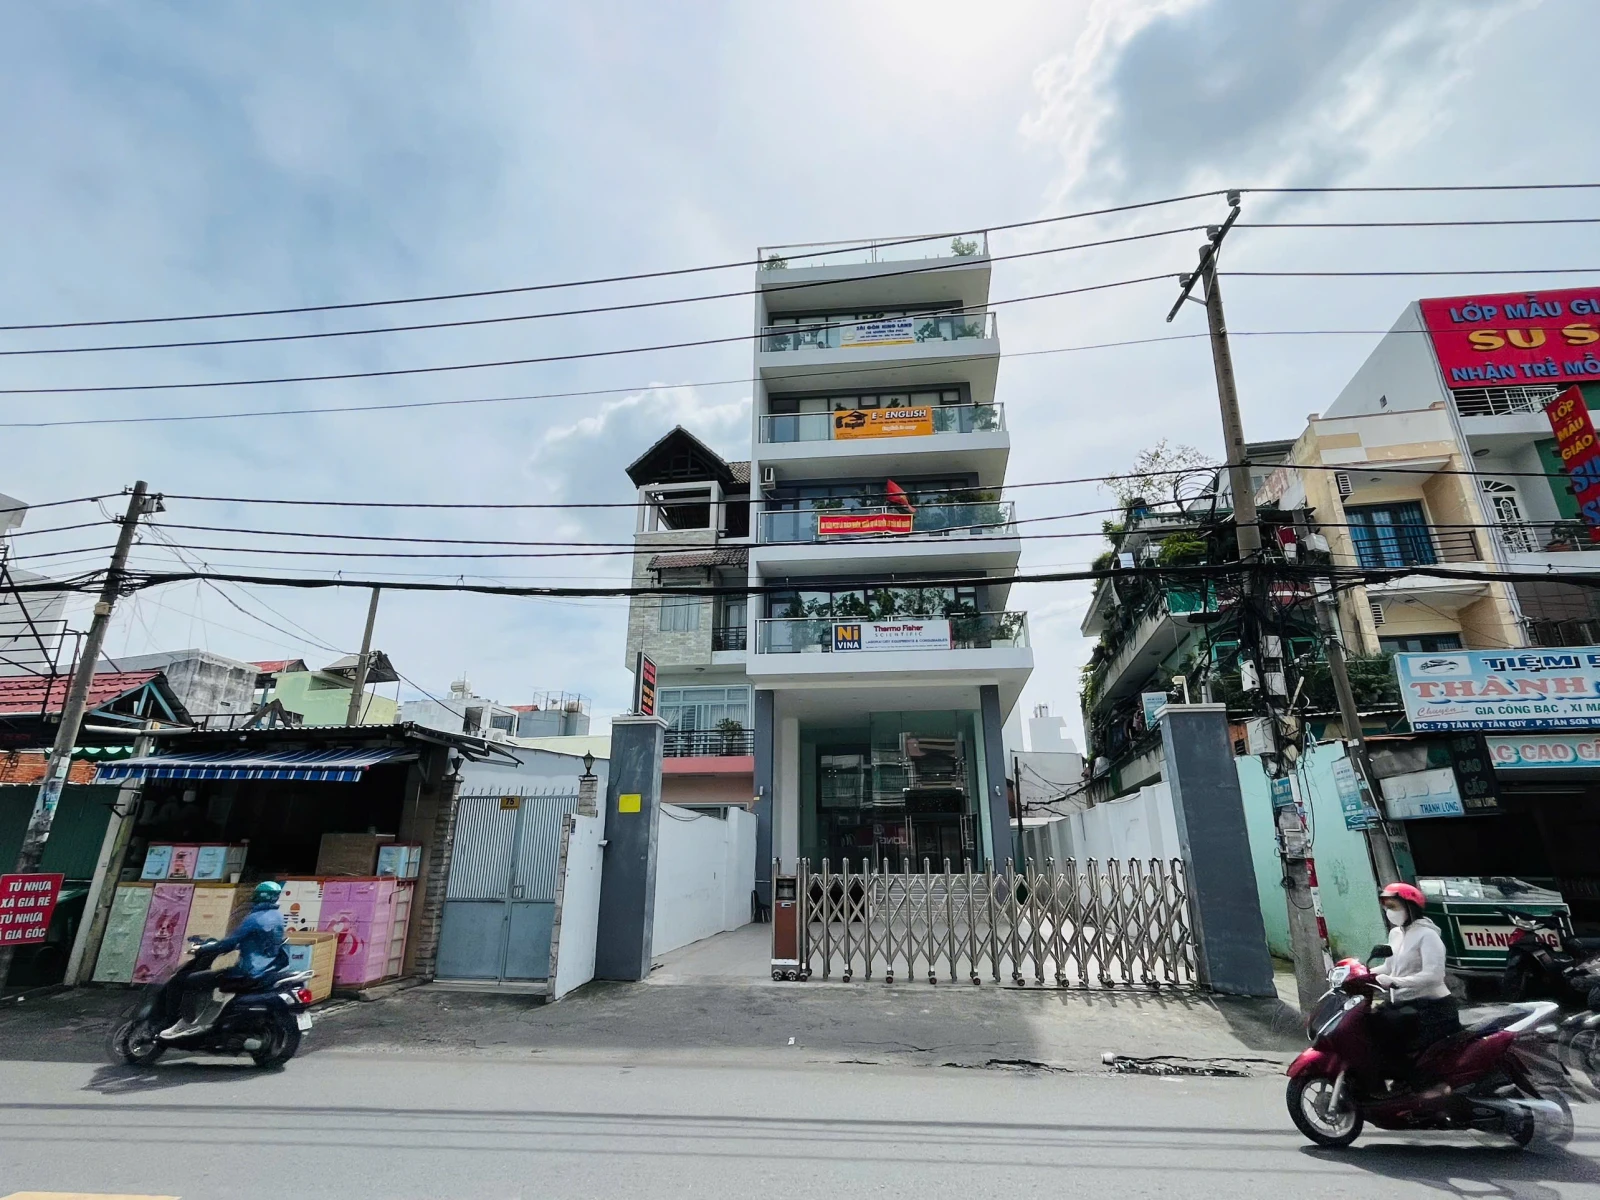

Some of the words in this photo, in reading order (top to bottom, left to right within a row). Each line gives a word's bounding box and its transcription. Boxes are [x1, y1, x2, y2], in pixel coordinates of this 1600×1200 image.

[1450, 301, 1498, 323] LỚP
[1504, 294, 1562, 319] MẪU
[1468, 327, 1546, 350] SU
[1451, 361, 1516, 383] NHẬN
[1520, 356, 1559, 378] TRẺ
[872, 412, 878, 420] E
[885, 409, 927, 419] ENGLISH
[1561, 434, 1594, 460] GIÁO
[838, 626, 859, 640] Ni
[903, 624, 924, 632] Fisher
[838, 641, 860, 649] VINA
[1482, 654, 1578, 671] TIỆM
[1410, 675, 1588, 698] THÀNH
[1475, 706, 1495, 715] GIA
[1498, 704, 1531, 715] CÔNG
[1534, 704, 1559, 715] BẠC
[1570, 703, 1582, 713] XI
[1521, 744, 1570, 760] CAO
[505, 797, 515, 805] 75
[1443, 802, 1459, 812] LONG
[9, 879, 22, 892] TỦ
[24, 881, 52, 893] NHỰA
[0, 895, 15, 908] XẢ
[17, 895, 35, 908] GIÁ
[37, 894, 51, 907] RẺ
[0, 911, 14, 924] TỦ
[14, 912, 43, 924] NHỰA
[5, 927, 22, 940] GIÁ
[25, 926, 46, 938] GỐC
